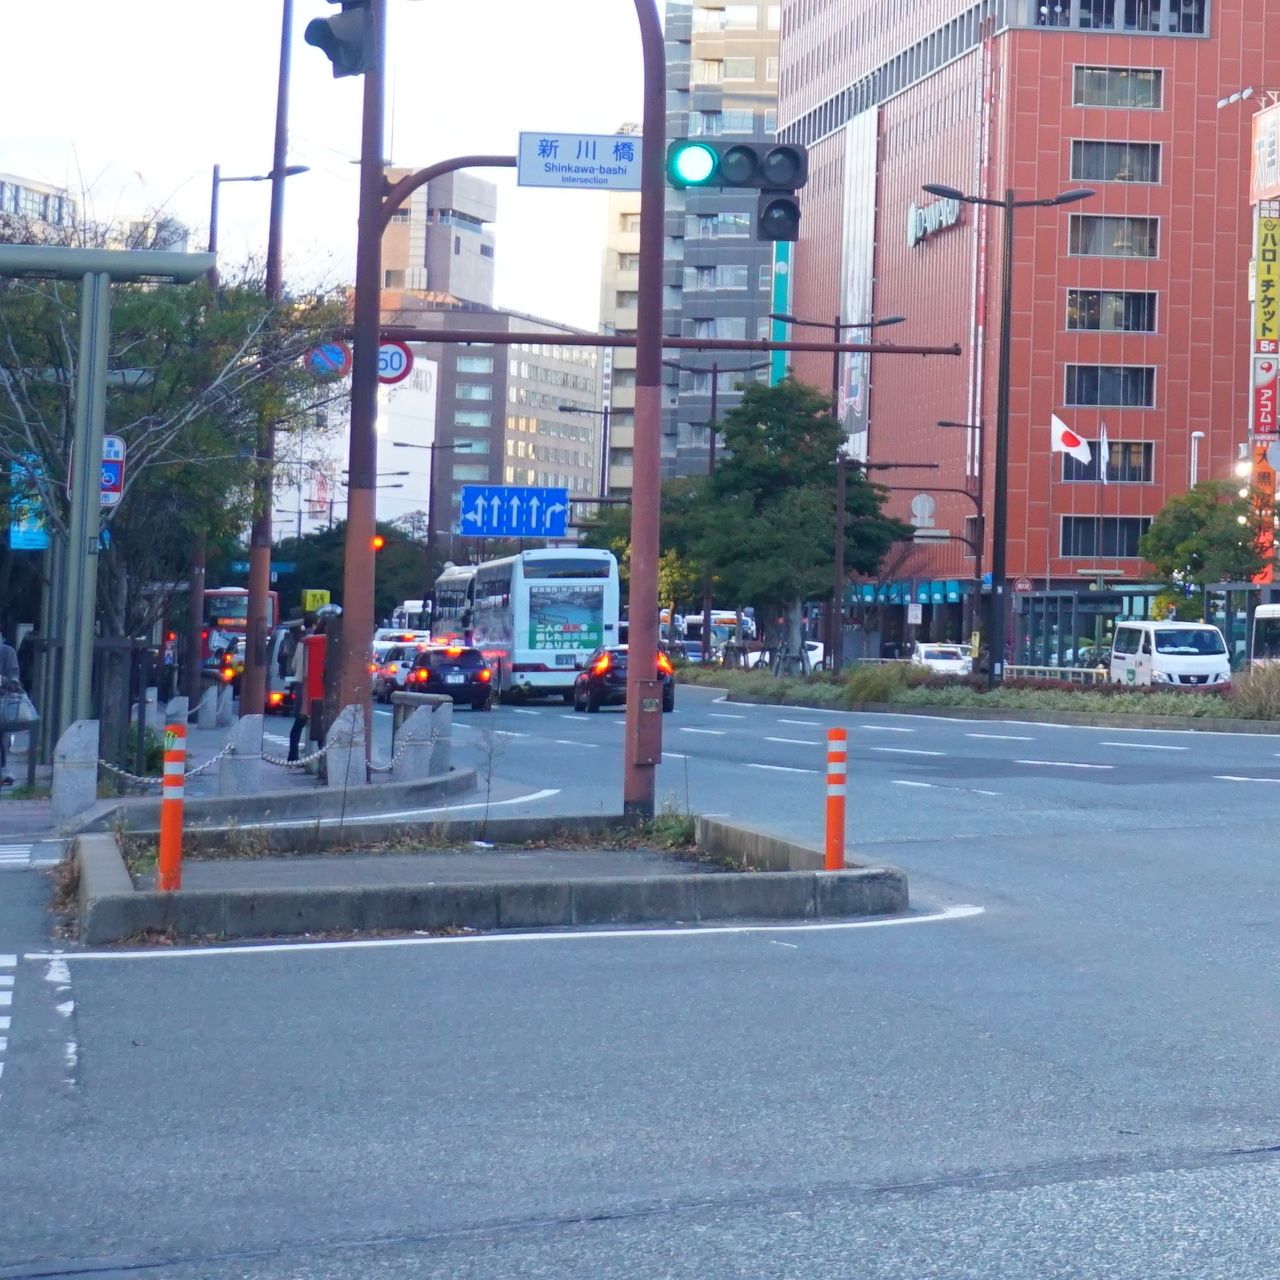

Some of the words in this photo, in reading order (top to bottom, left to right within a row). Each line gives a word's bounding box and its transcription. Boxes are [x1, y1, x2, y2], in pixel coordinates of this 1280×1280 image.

[538, 137, 634, 162] 新川橋
[544, 162, 627, 175] Shinkawa-bashi
[561, 175, 608, 185] Intersection
[1261, 233, 1277, 337] ハローチケット
[1259, 340, 1276, 352] 5F
[1260, 389, 1273, 423] アコム
